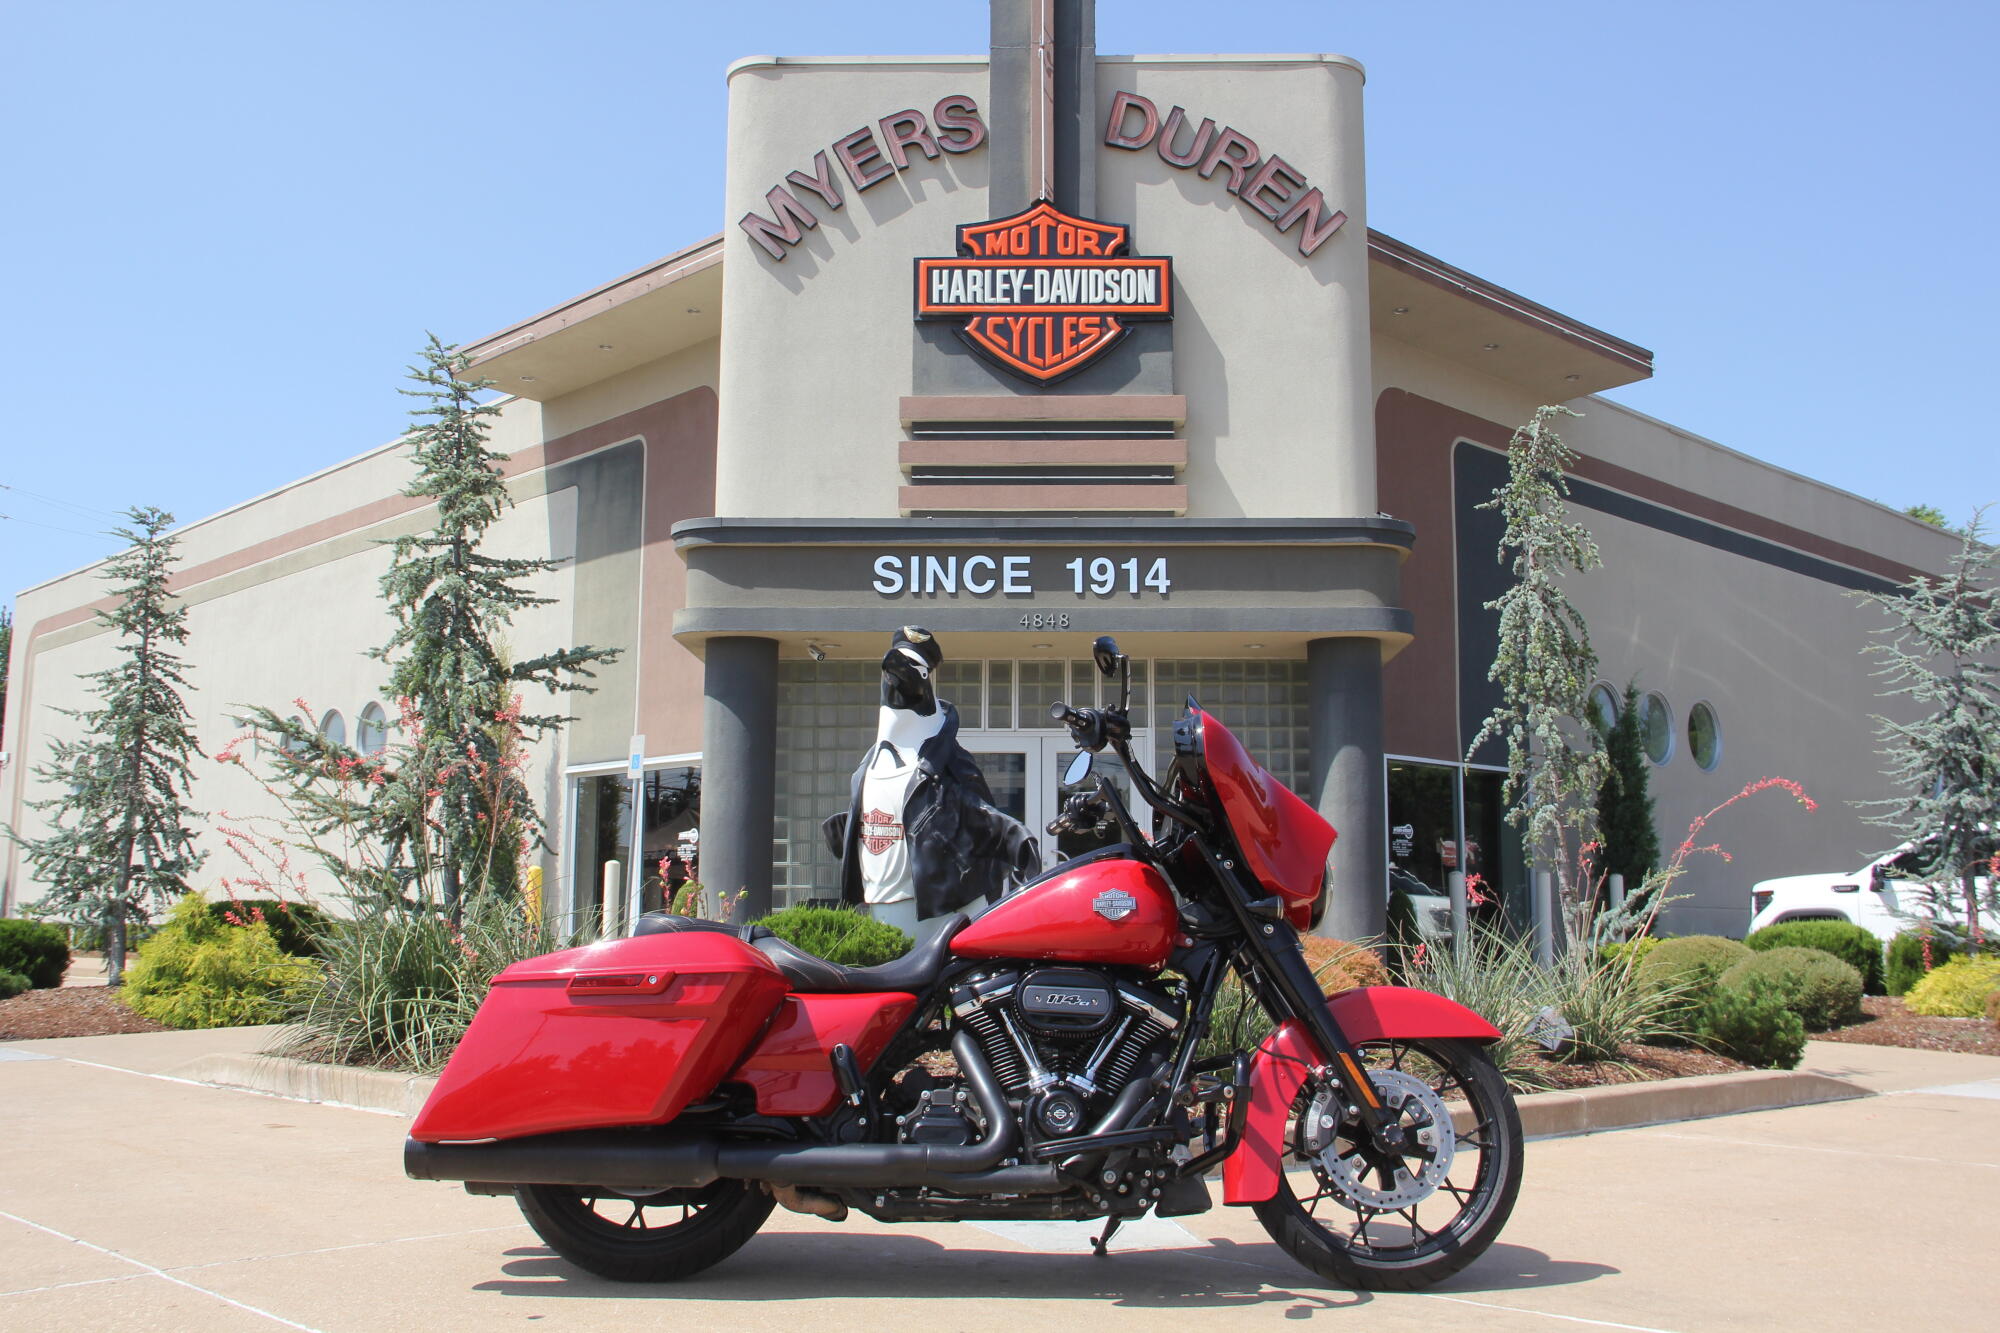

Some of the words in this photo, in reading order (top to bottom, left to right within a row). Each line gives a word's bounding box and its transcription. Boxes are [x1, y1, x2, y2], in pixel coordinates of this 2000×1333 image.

[738, 94, 986, 261] MYERS
[1104, 89, 1348, 258] DUREN
[985, 213, 1103, 256] MOTOR
[932, 268, 1156, 304] HARLEY-DAVIDSON
[986, 316, 1102, 367] CYCLES
[872, 555, 1032, 594] SINCE
[1065, 557, 1171, 595] 1914
[1019, 613, 1070, 628] 4848
[862, 825, 901, 837] LEY-DAVIDSON
